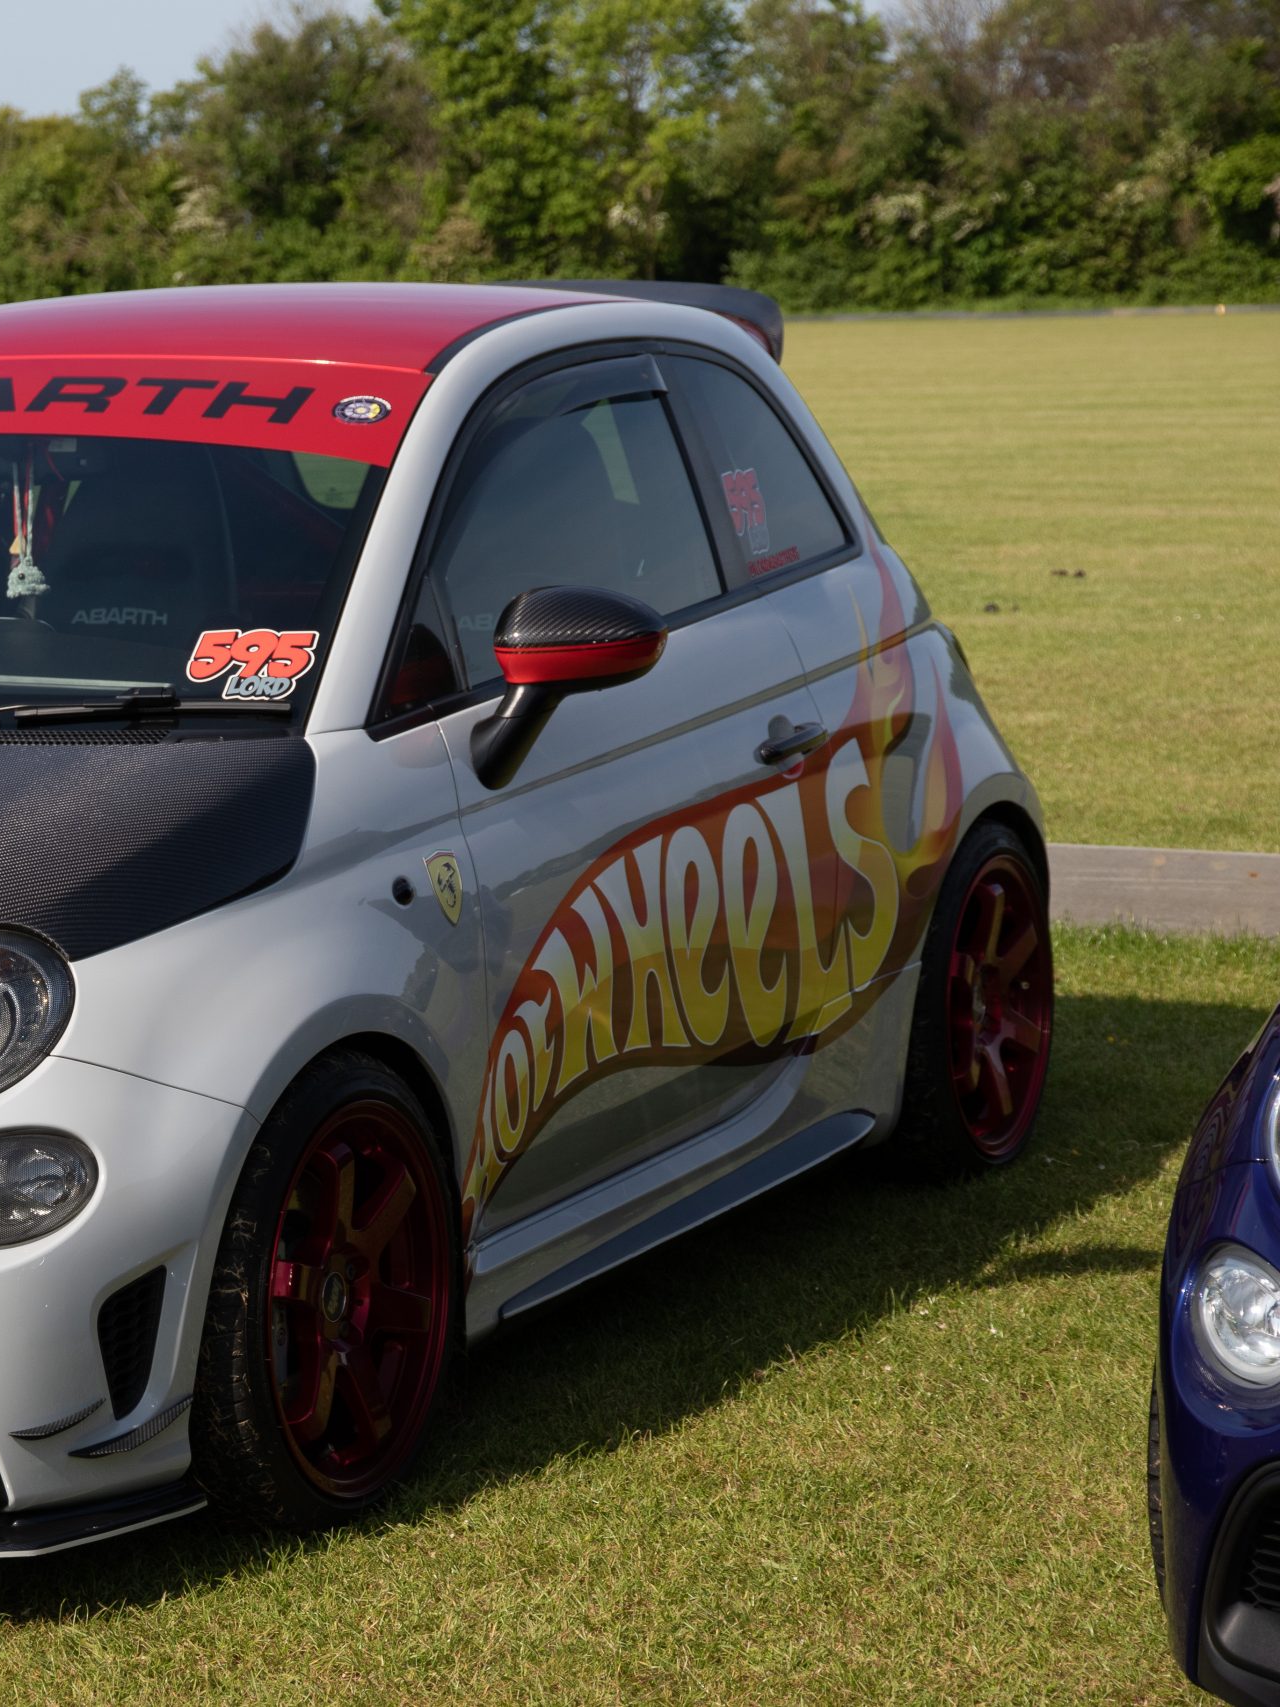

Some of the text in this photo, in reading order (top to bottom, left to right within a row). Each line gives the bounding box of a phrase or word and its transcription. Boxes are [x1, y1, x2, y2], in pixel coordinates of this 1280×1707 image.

[71, 606, 168, 626] ABARTH
[189, 630, 317, 681] 595
[226, 675, 293, 697] LORD
